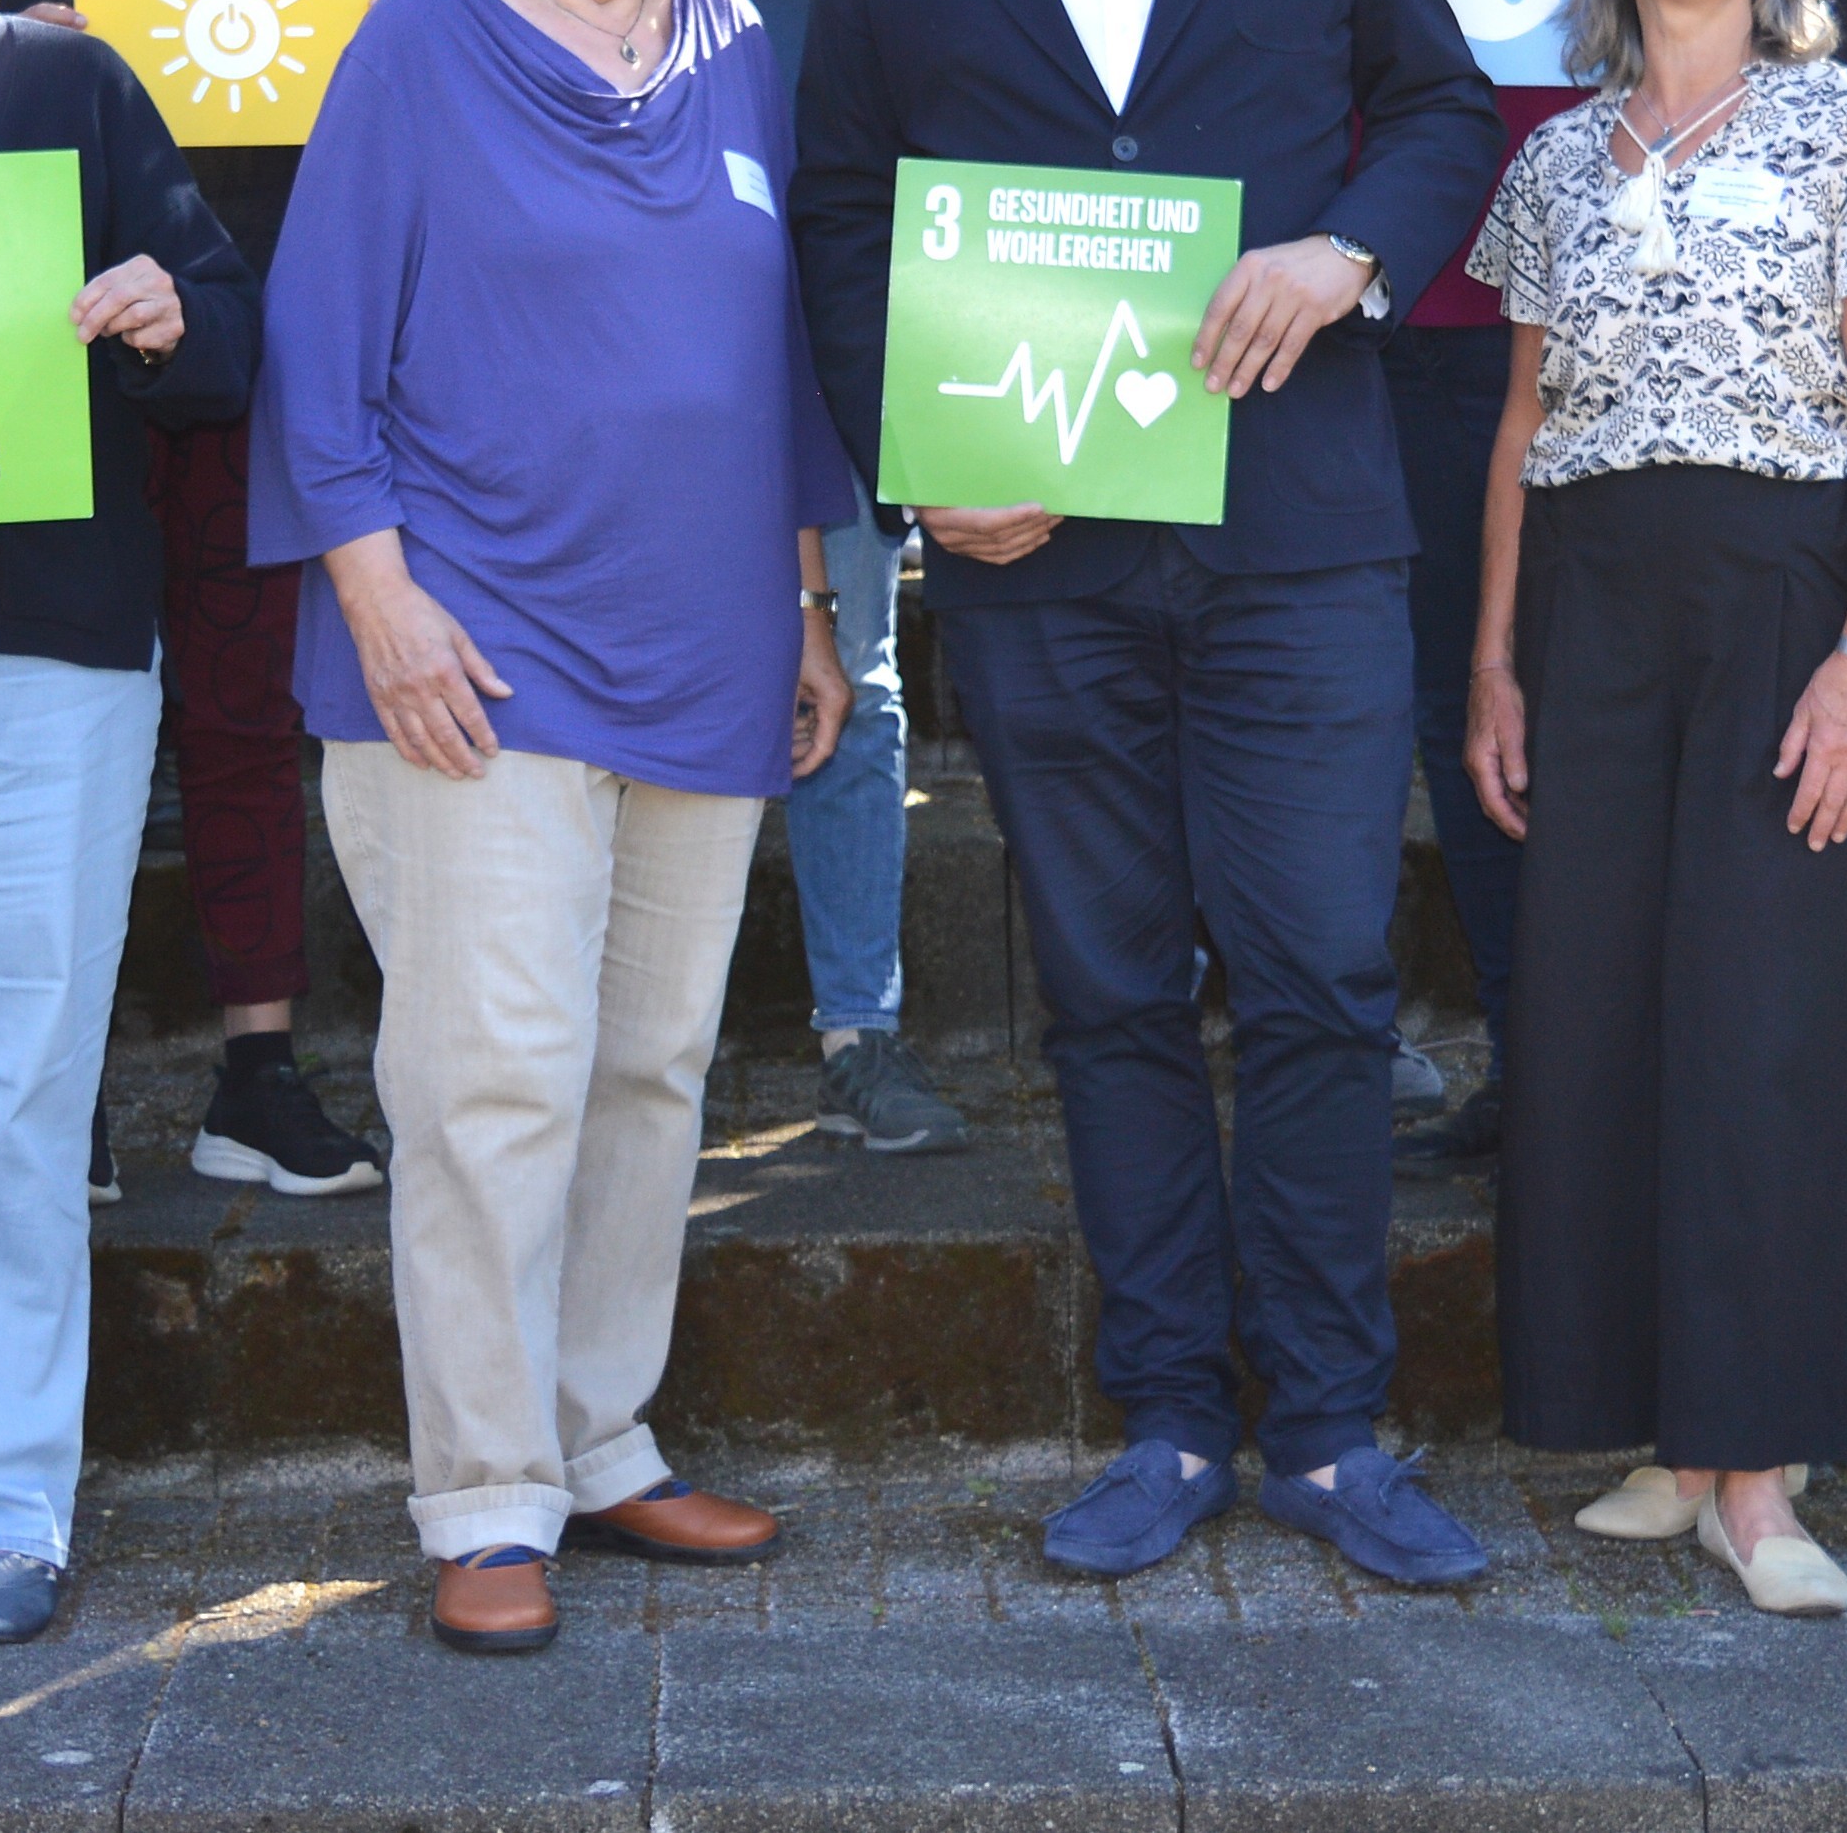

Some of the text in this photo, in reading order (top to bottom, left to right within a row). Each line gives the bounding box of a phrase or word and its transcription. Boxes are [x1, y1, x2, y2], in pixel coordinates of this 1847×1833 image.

[922, 184, 1200, 261] 3 GESUNDHEIT UND
[987, 229, 1171, 273] WOHLERGEHEN
